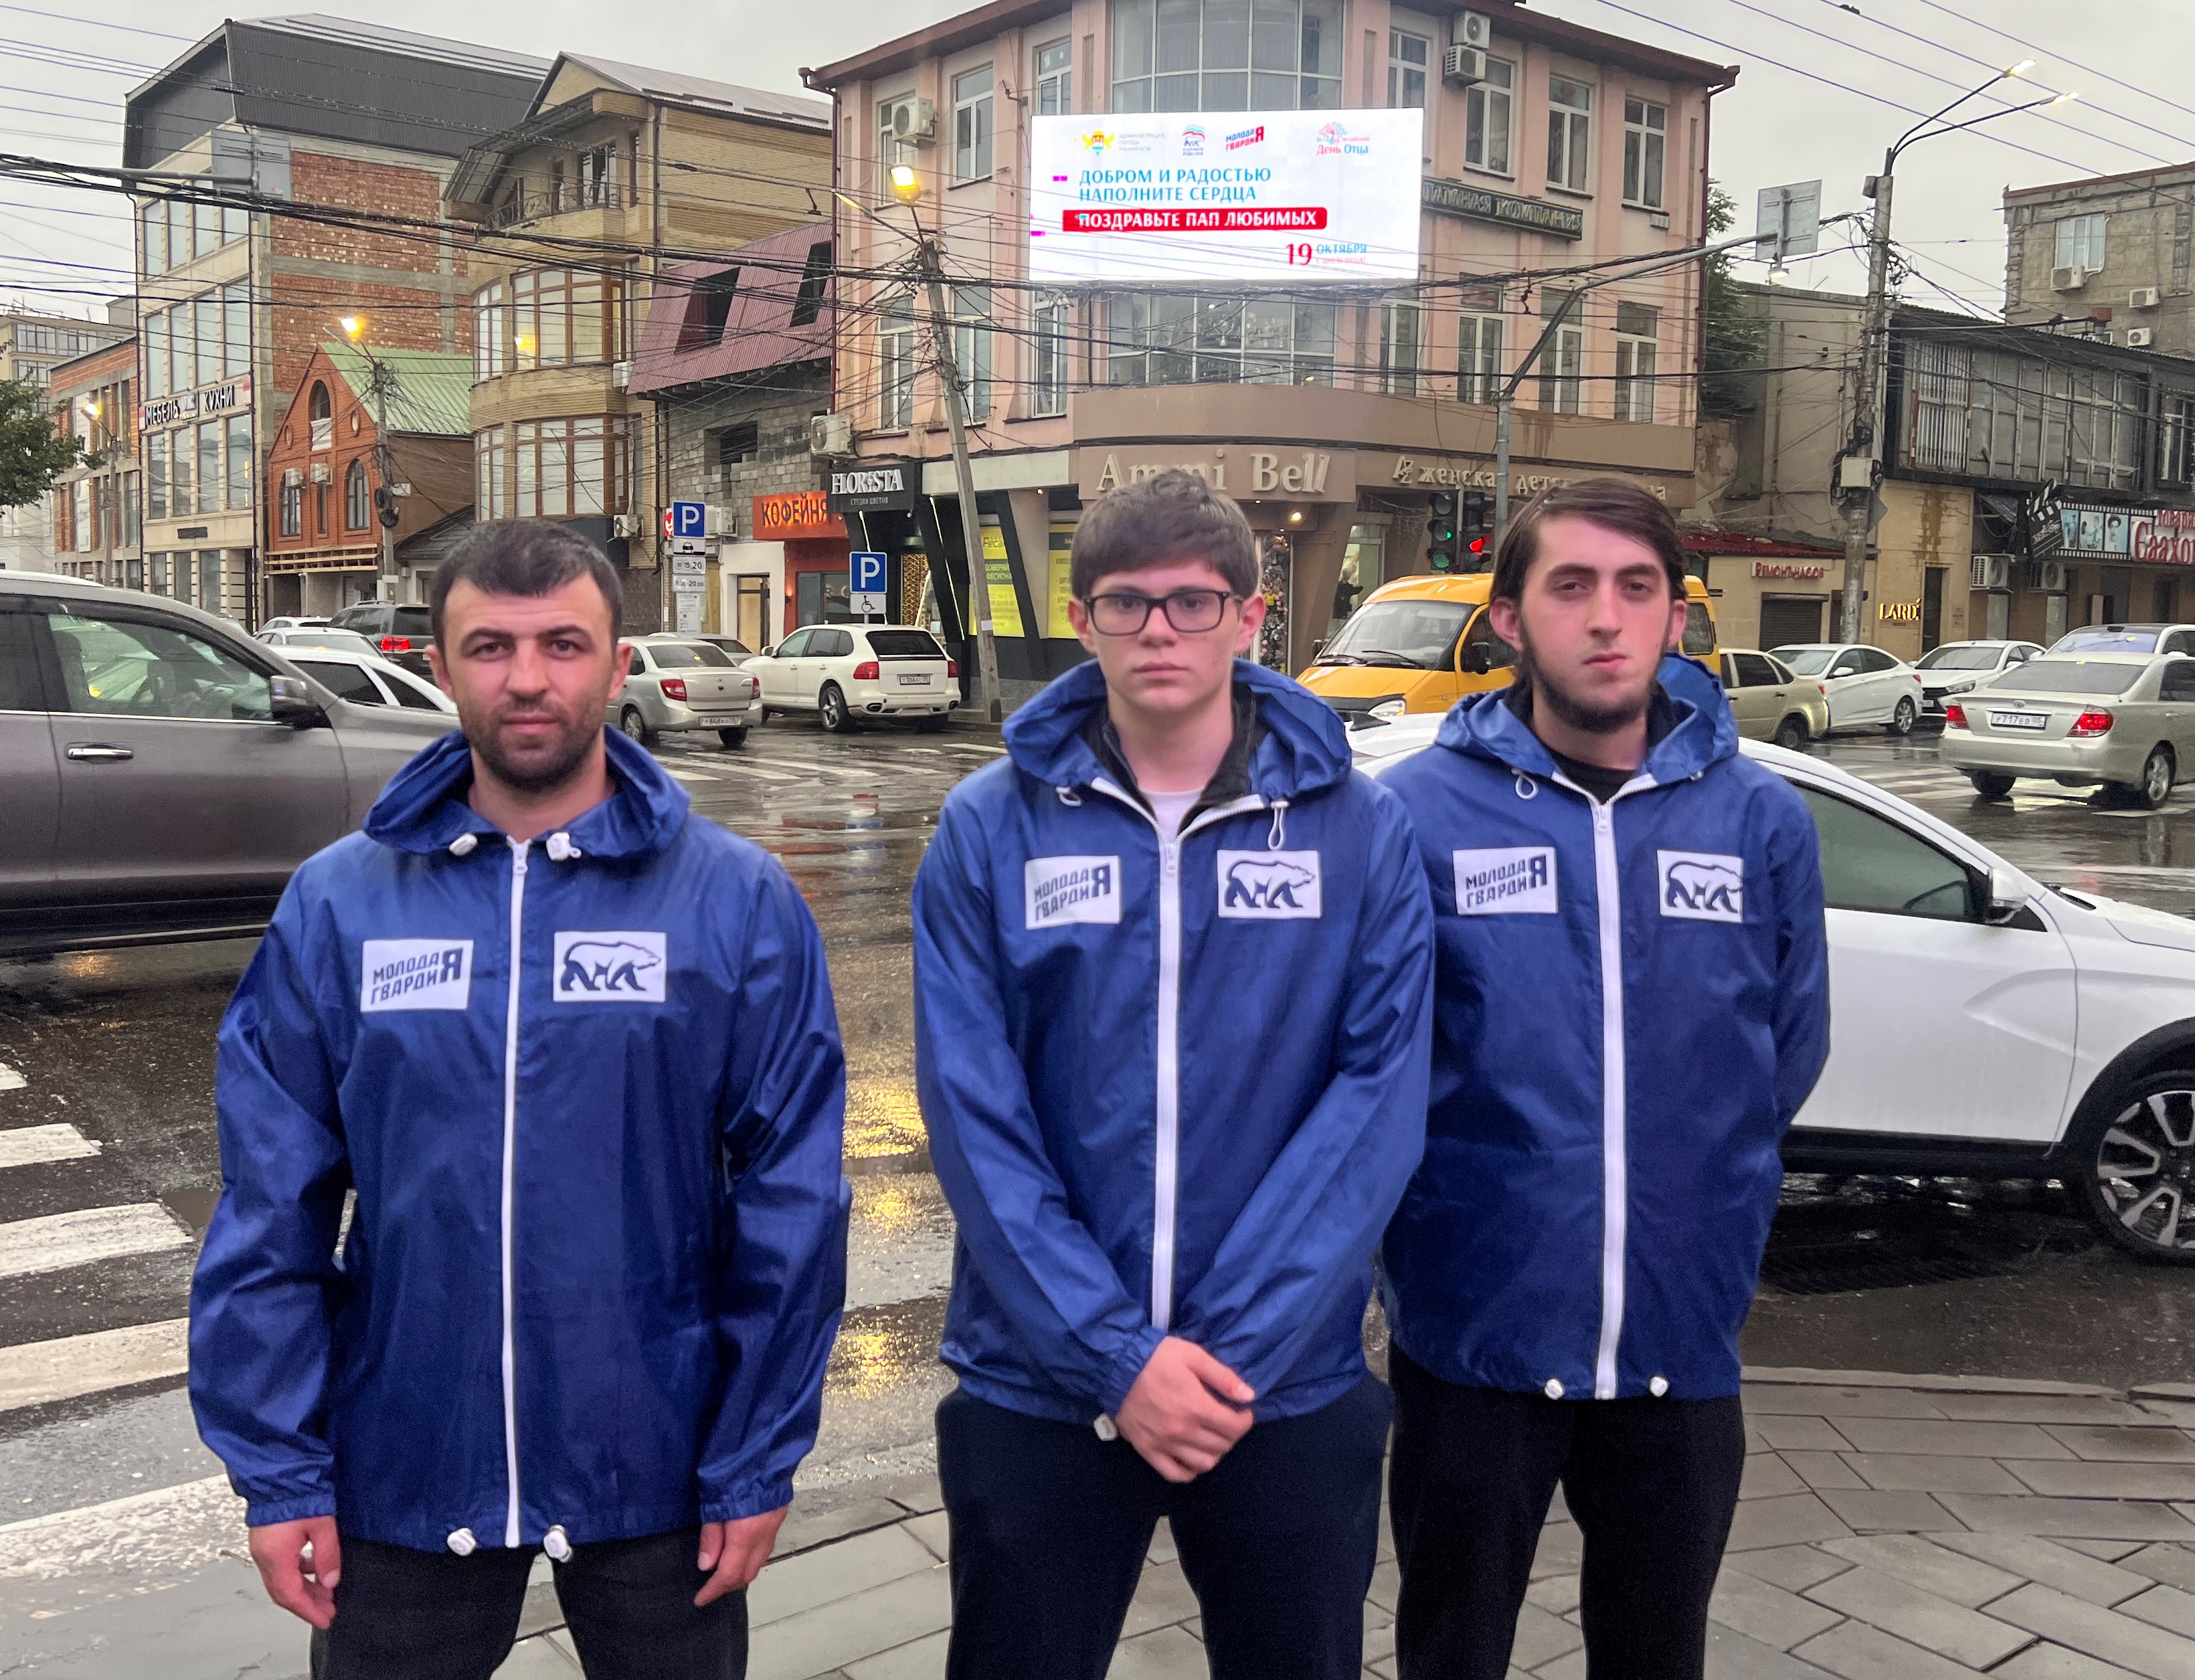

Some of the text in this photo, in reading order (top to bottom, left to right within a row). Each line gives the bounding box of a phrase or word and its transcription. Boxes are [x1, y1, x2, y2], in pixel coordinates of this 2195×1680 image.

[1316, 144, 1369, 156] День Отца
[1079, 168, 1271, 187] ДОБРОМ И РАДОСТЬЮ
[1079, 187, 1256, 203] НАПОЛНИТЕ СЕРДЦА
[1078, 211, 1317, 230] ПОЗДРАВЬТЕ ПАП ЛЮБИМЫХ
[1285, 243, 1367, 266] 19 ОКТЯБРЯ
[145, 399, 180, 426] МЕБЕЛЬ
[203, 385, 235, 413] КУХНИ
[831, 469, 904, 495] FLORISTA
[1250, 453, 1330, 493] Bell
[1417, 466, 1498, 487] женска
[682, 506, 700, 533] P
[762, 493, 829, 527] КОФЕЙНЯ
[2133, 521, 2195, 563] Саахо
[693, 561, 702, 569] 20
[861, 557, 880, 588] P
